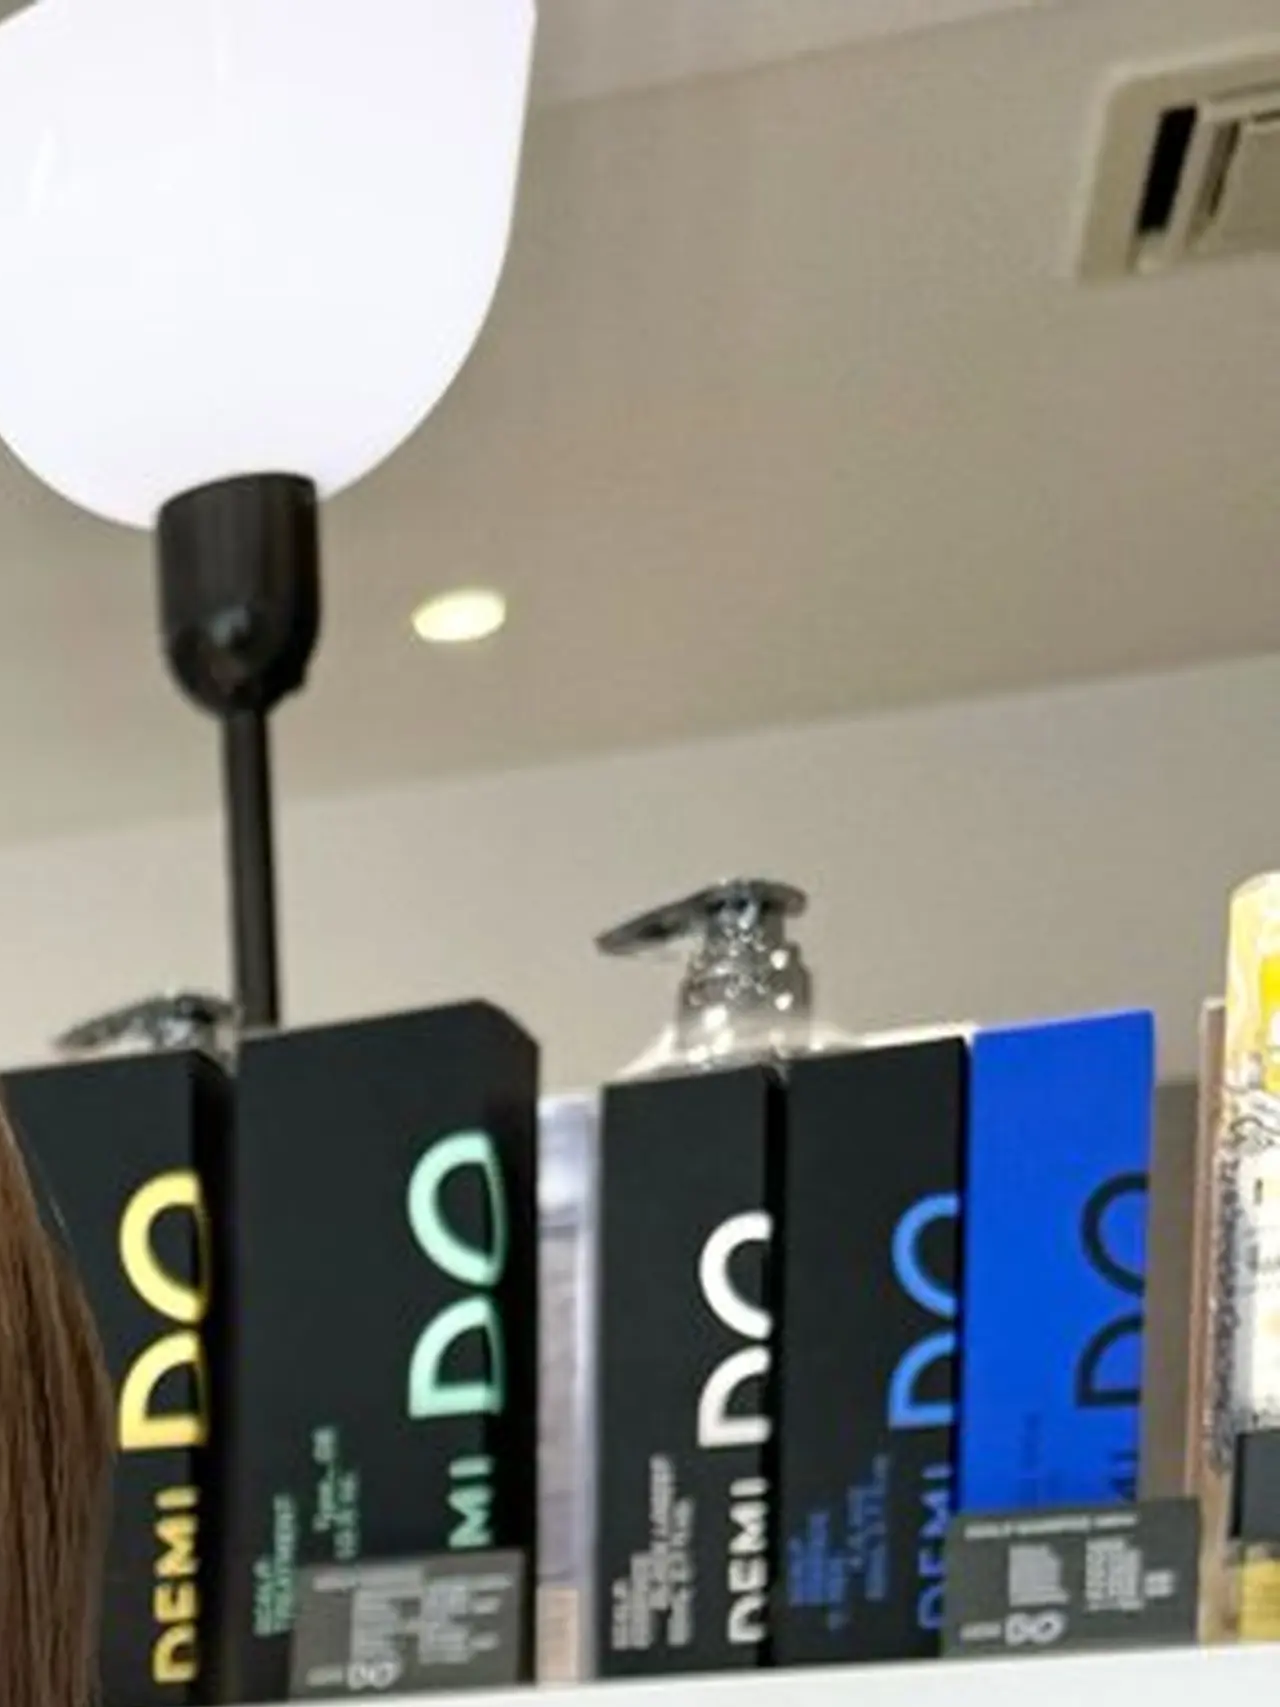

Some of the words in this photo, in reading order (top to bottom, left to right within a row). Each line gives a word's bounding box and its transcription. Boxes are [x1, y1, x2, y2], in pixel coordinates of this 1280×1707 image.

[119, 1168, 210, 1450] DO
[408, 1130, 506, 1420] DO
[153, 1485, 200, 1685] DEMI
[448, 1453, 496, 1549] MI
[727, 1477, 770, 1645] DEMI
